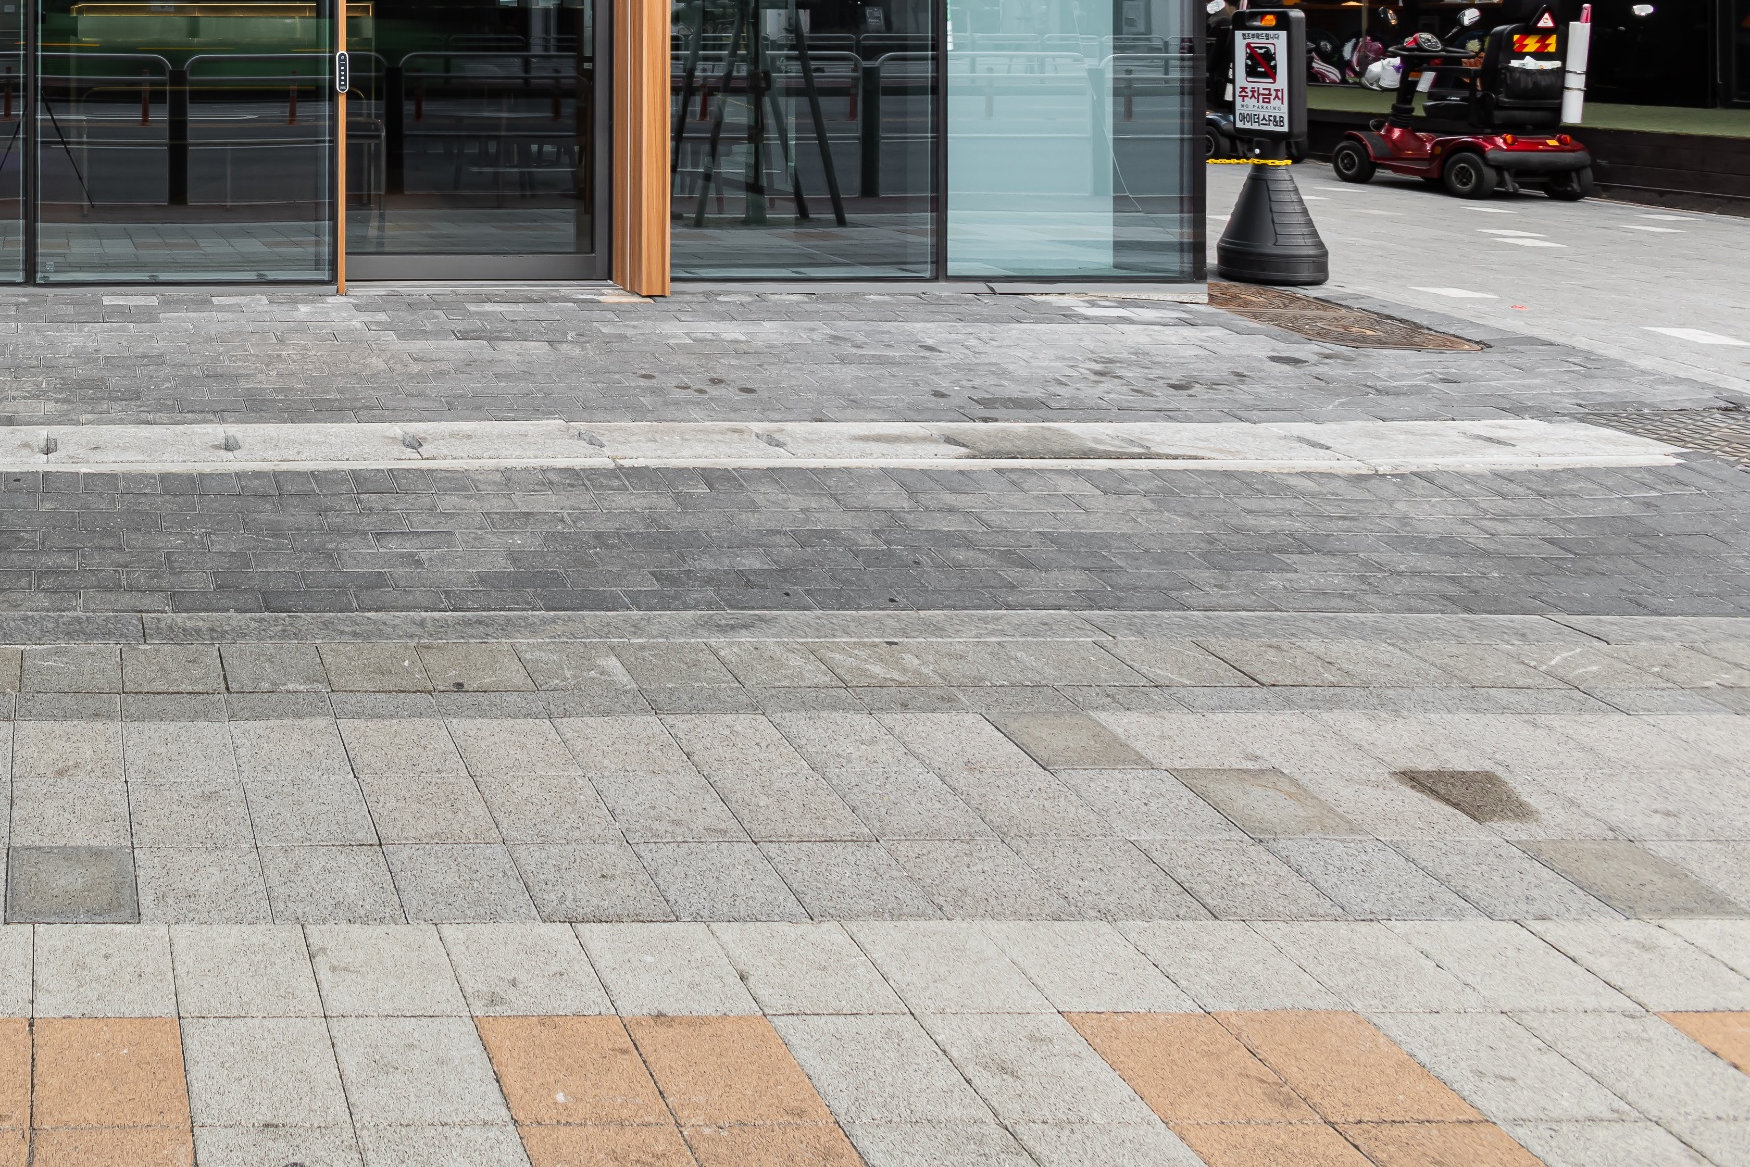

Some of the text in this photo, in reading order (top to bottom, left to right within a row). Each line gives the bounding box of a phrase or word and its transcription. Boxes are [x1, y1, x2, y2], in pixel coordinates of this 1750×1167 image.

[1237, 86, 1285, 106] 주차금지
[1252, 104, 1282, 112] PARKING
[1238, 112, 1285, 128] 아이더스F&B
